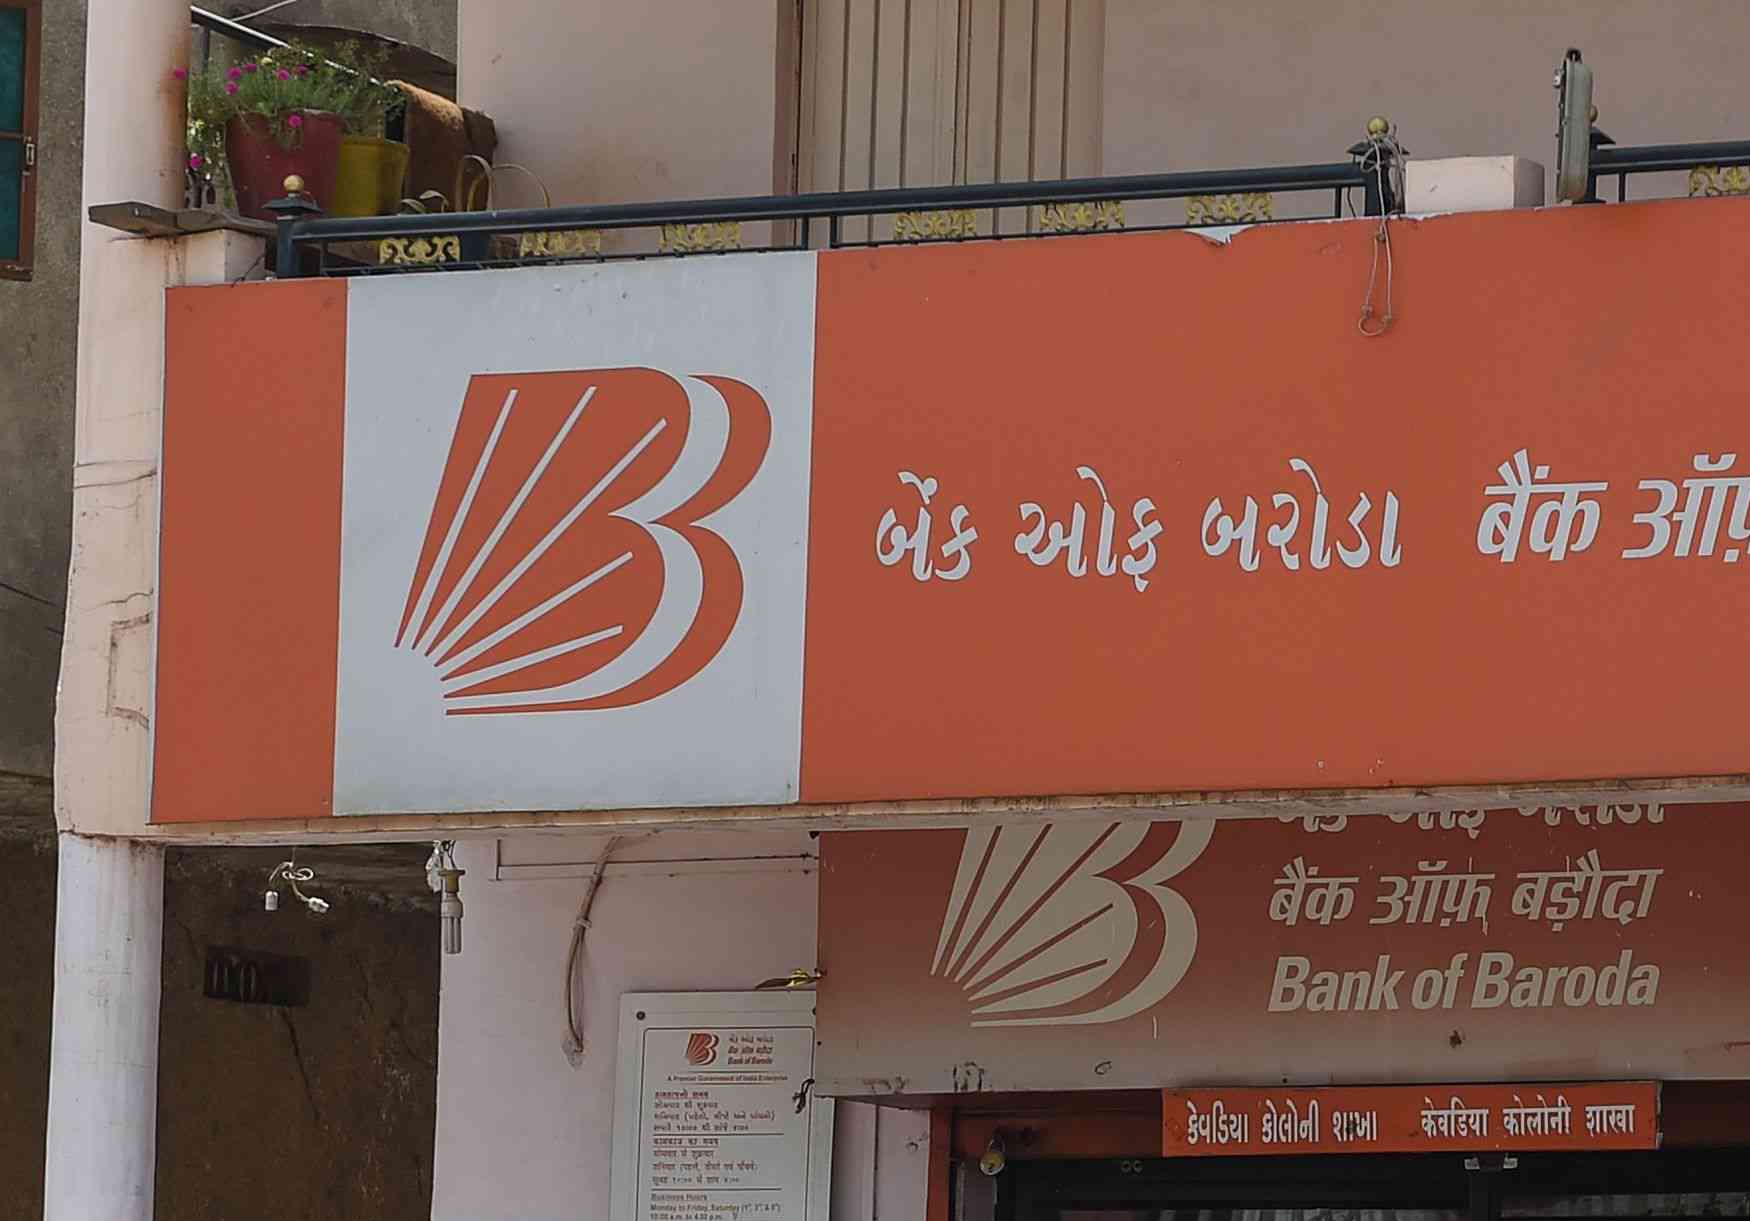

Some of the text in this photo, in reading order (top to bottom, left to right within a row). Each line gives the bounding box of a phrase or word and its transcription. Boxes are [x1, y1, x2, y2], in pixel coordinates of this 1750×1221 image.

[1202, 458, 1401, 571] બરોડા
[1477, 449, 1608, 562] बैंक
[1267, 855, 1360, 926] बैंक
[1511, 848, 1664, 932] बड़ौदा
[1266, 947, 1661, 1012] Bank of Baroda
[1186, 1099, 1249, 1146] કેવડિયા
[1260, 1097, 1320, 1144] કોલોની
[1420, 1094, 1635, 1138] केवडिया कोलोनी शाखा
